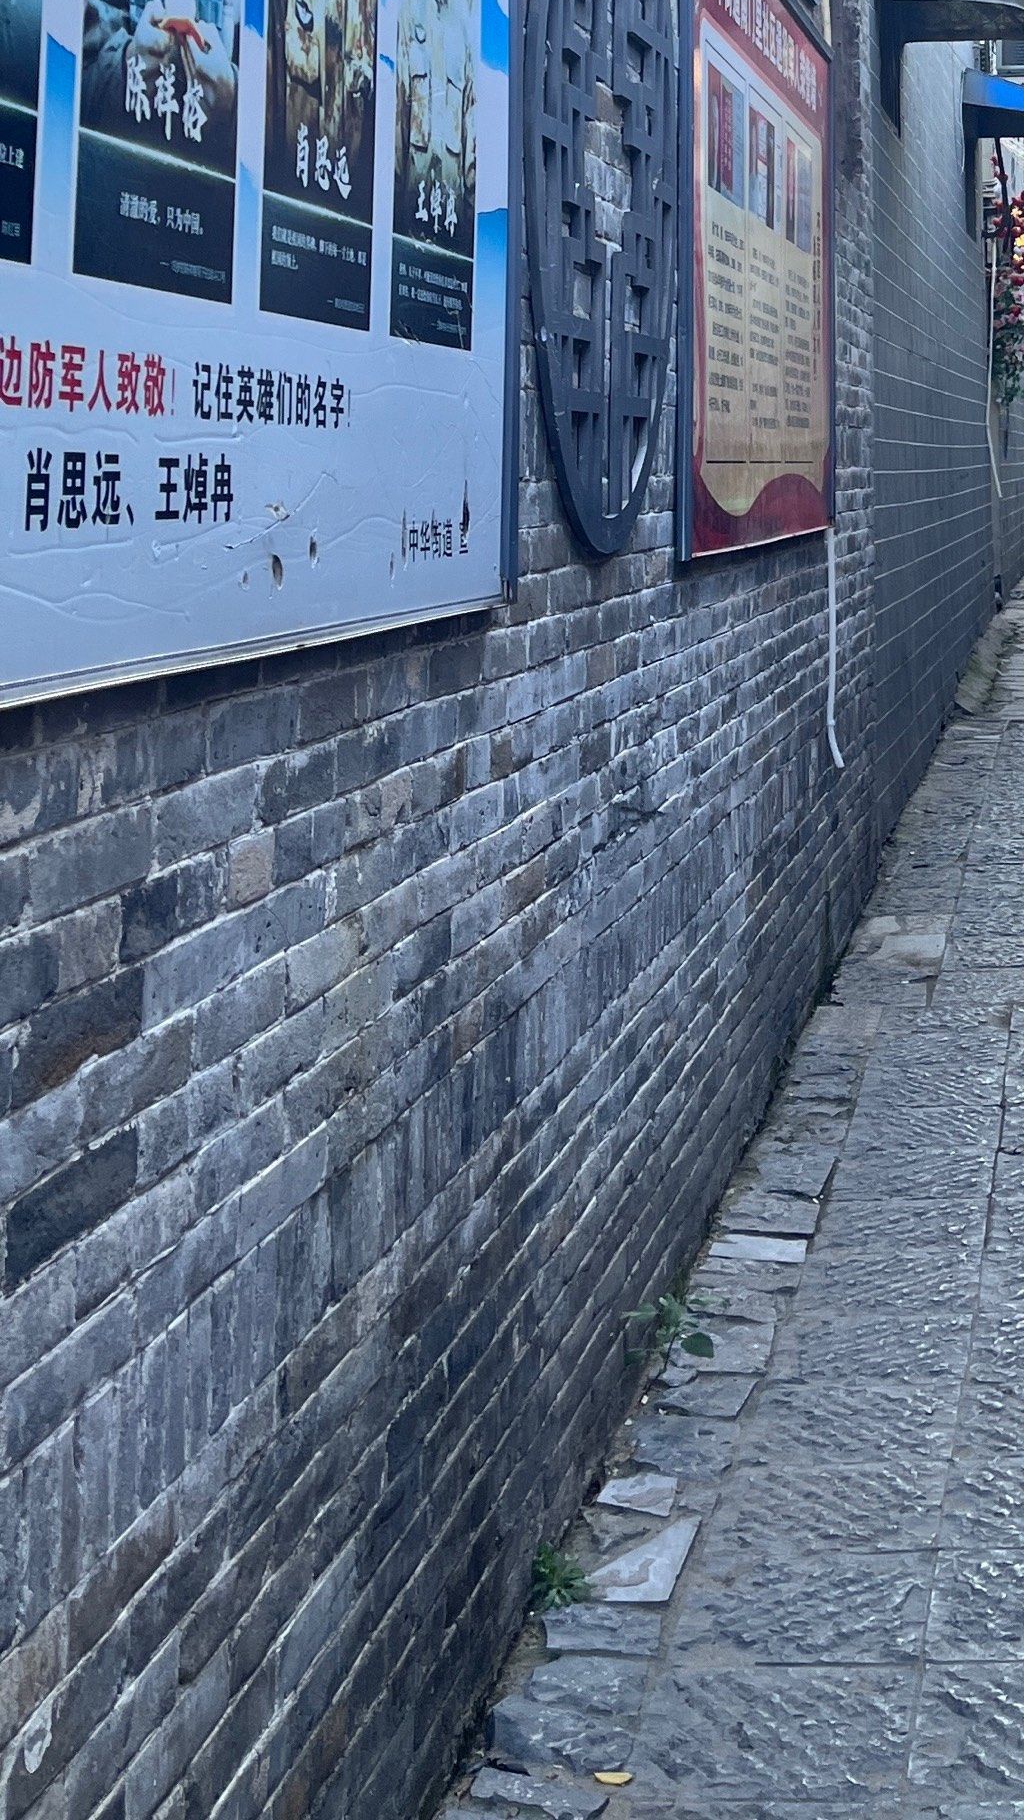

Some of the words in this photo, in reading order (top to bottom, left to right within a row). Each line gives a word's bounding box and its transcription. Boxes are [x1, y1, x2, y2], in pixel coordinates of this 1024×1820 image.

[124, 53, 207, 143] 陈祥榕
[296, 122, 352, 199] 肖思远
[25, 447, 234, 532] 肖思远、王焯冉
